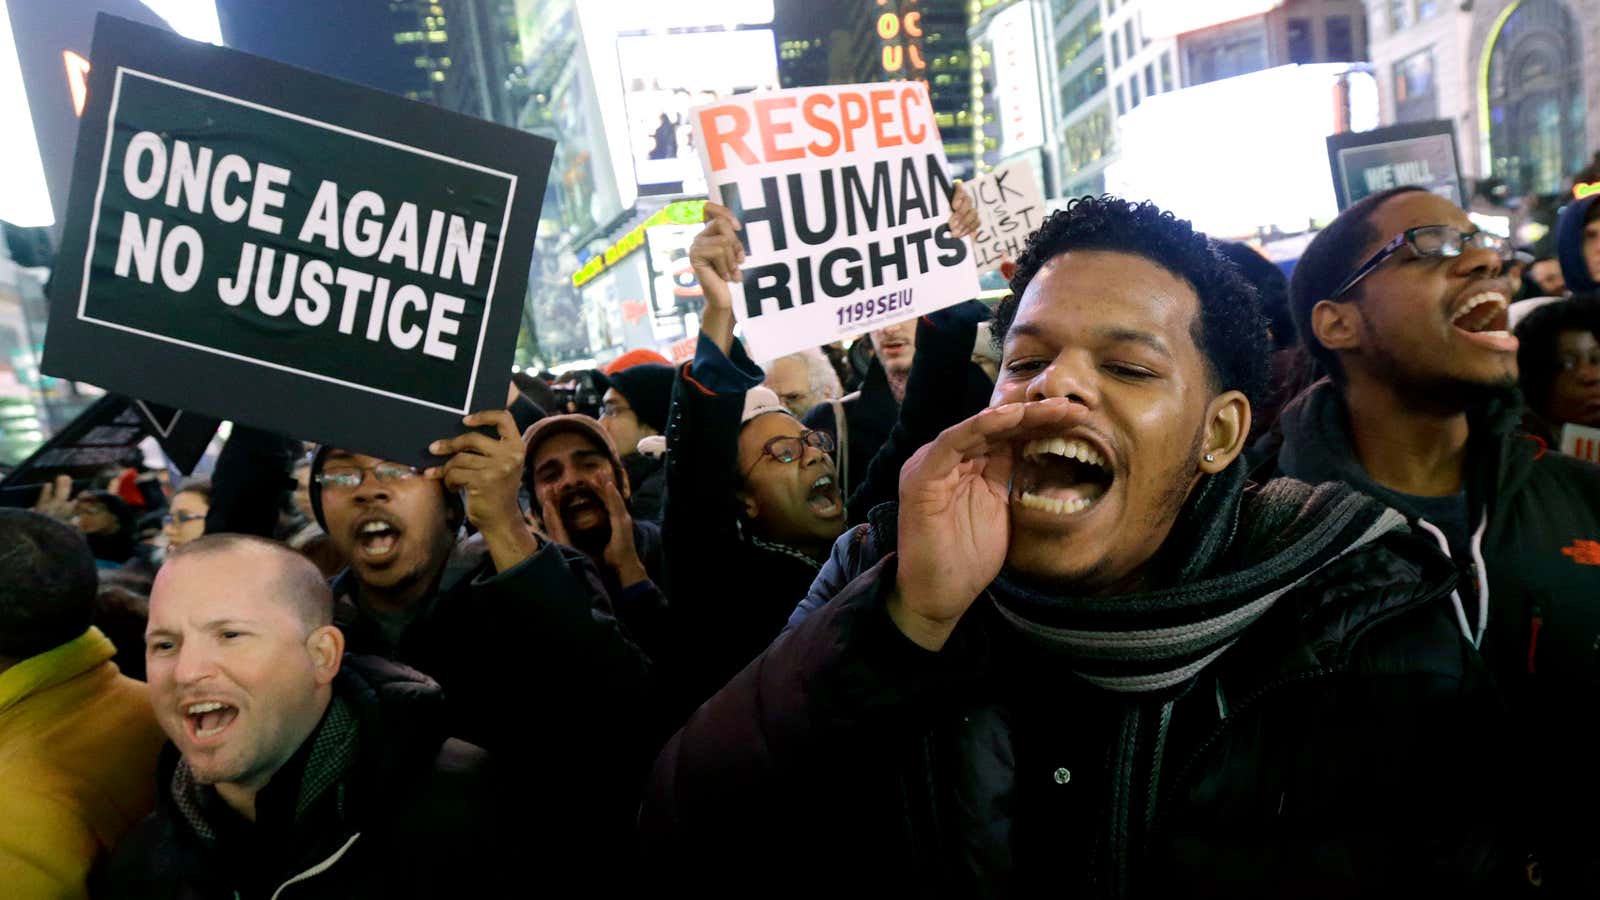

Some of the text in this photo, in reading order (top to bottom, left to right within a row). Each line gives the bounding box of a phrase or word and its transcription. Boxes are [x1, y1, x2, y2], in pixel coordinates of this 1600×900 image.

[699, 87, 934, 171] RESPEC
[1363, 160, 1435, 192] WE WILL
[123, 131, 291, 234] ONCE
[299, 180, 486, 286] AGAIN
[719, 154, 957, 257] HUMAN
[114, 212, 204, 293] NO
[218, 243, 465, 361] JUSTICE
[743, 222, 967, 318] RIGHTS
[837, 288, 913, 325] 1199SEIU
